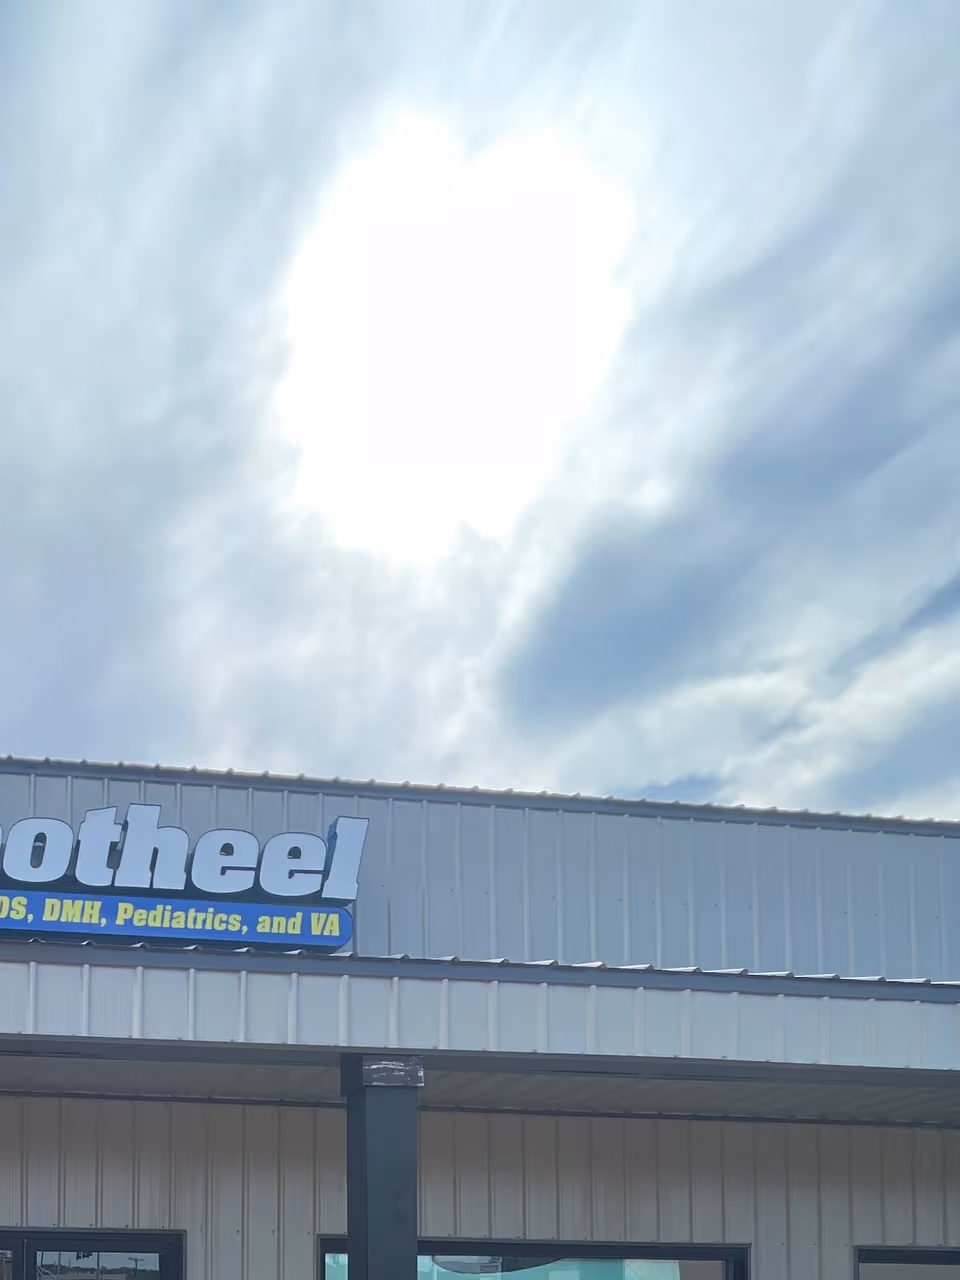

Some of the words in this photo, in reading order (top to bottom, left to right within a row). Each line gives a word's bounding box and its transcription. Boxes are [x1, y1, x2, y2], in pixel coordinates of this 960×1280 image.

[42, 898, 107, 928] DMH,
[115, 902, 248, 935] Pediatrics,
[256, 911, 303, 934] and
[310, 912, 340, 936] VA
